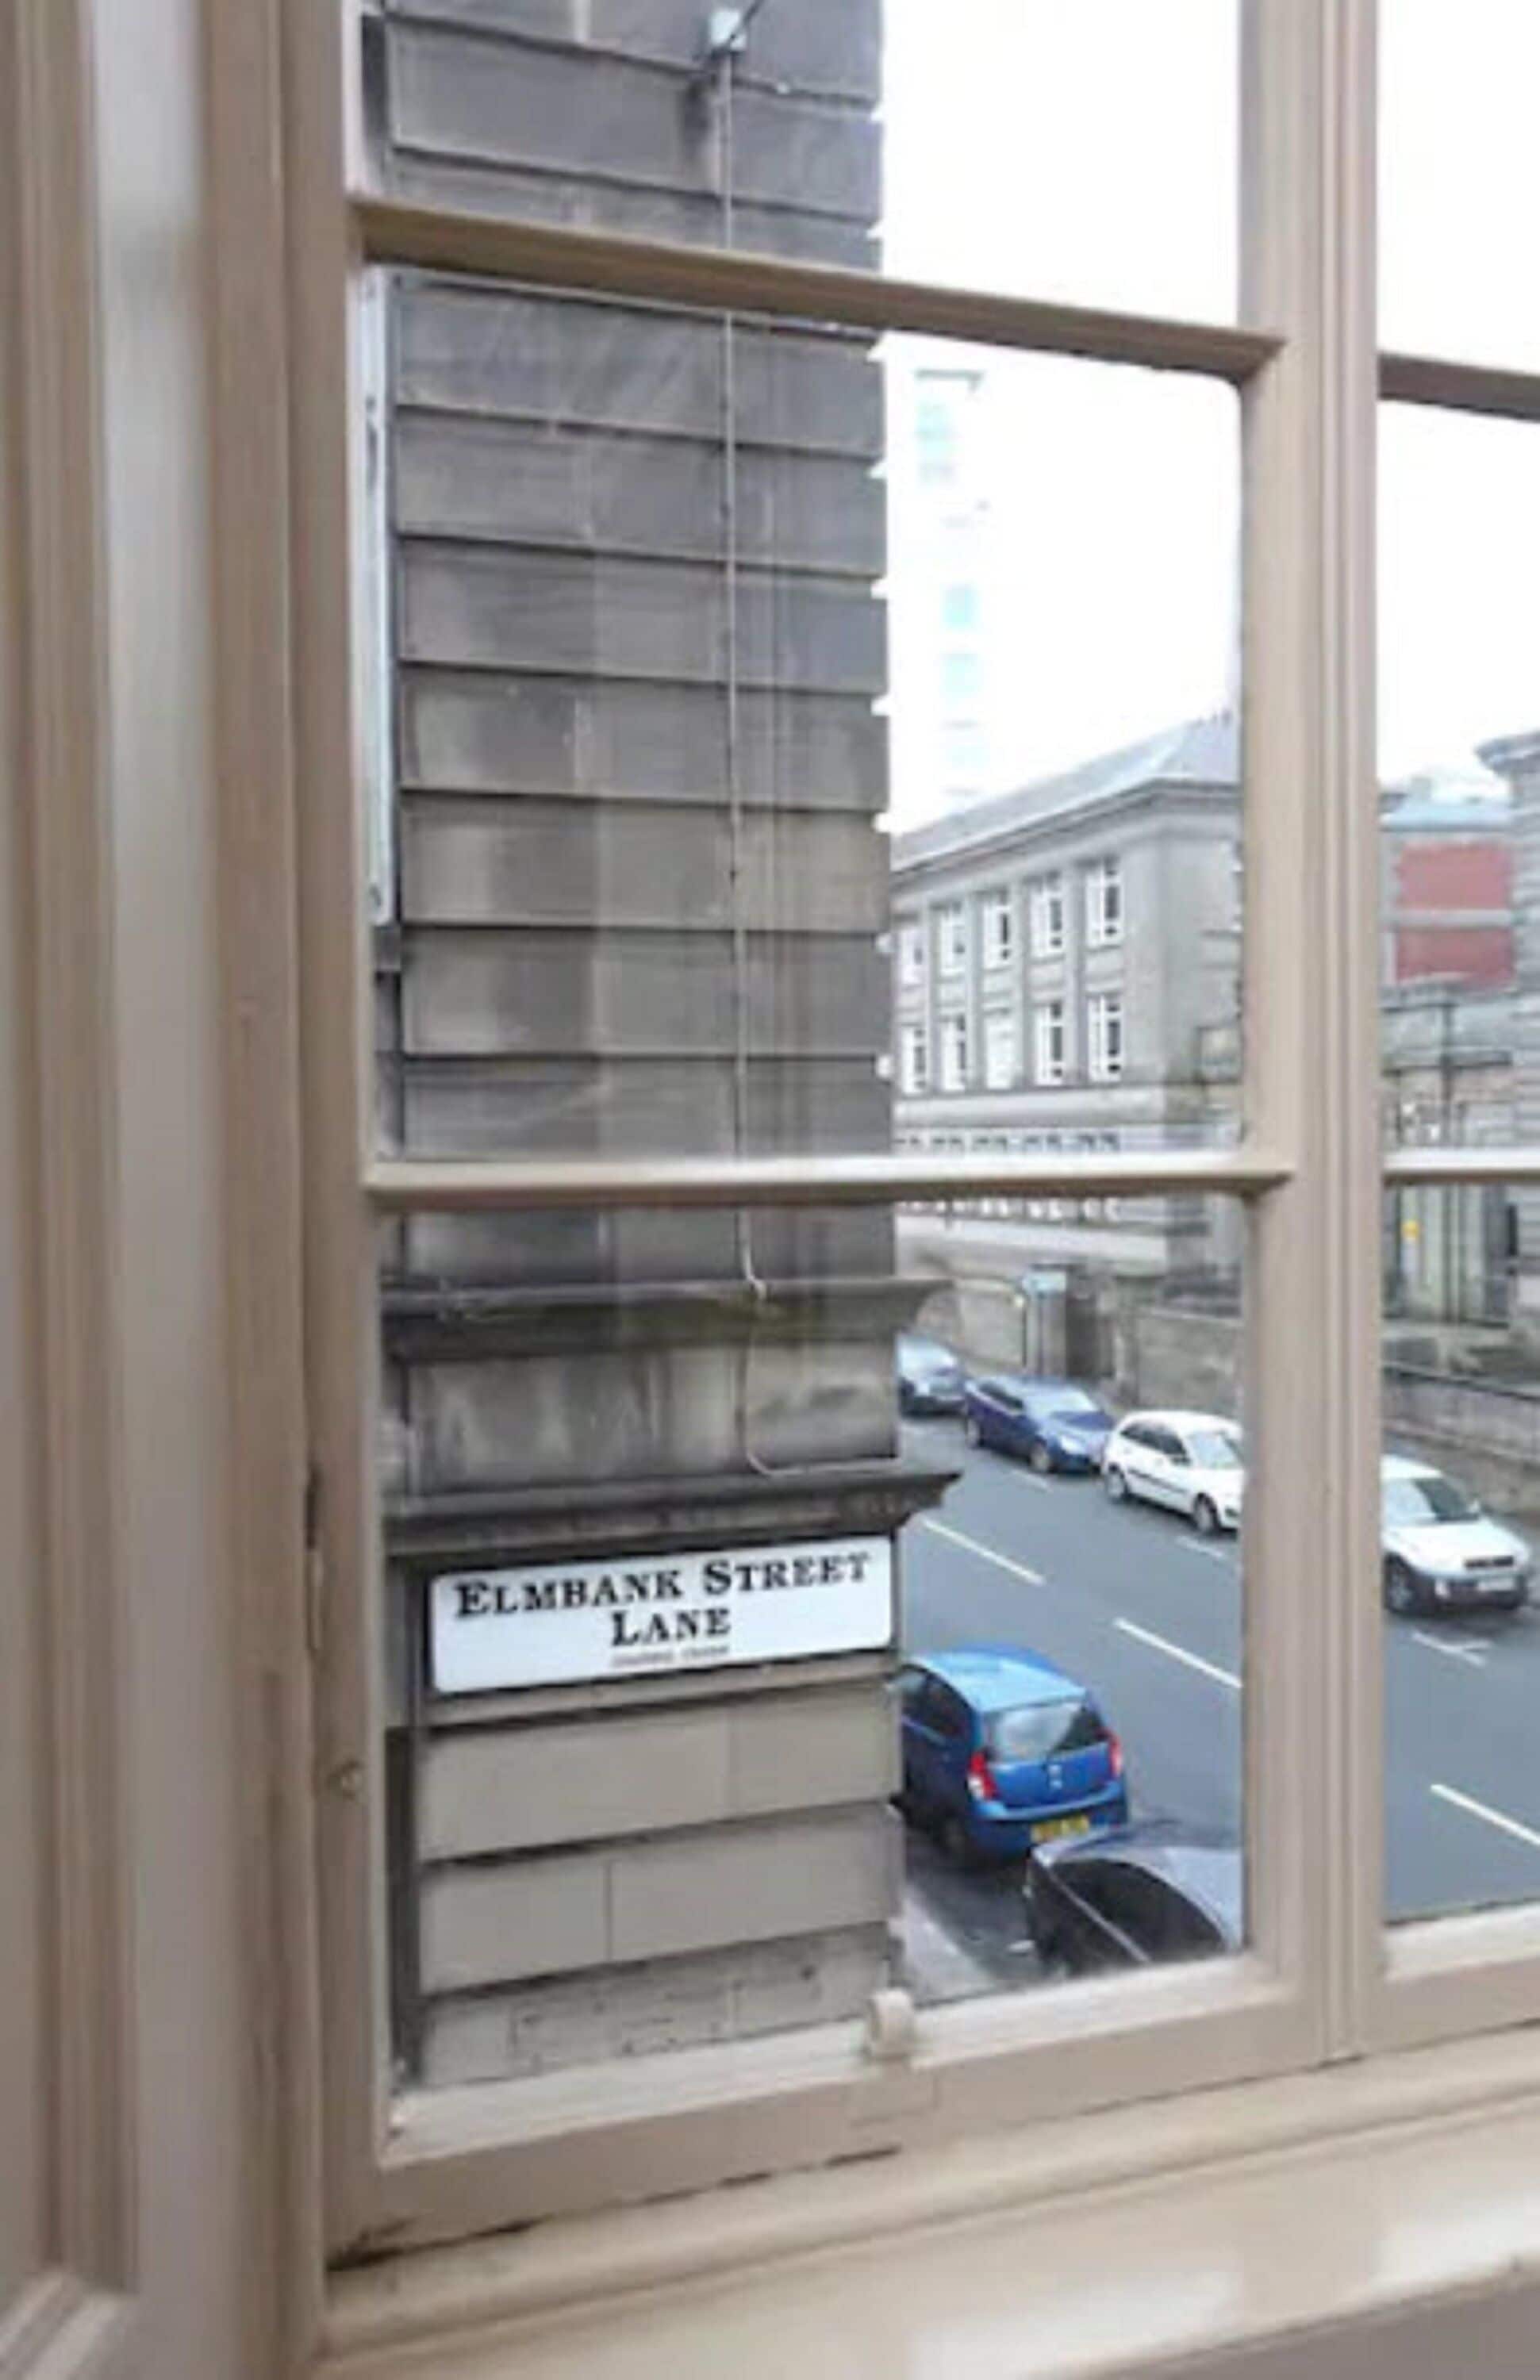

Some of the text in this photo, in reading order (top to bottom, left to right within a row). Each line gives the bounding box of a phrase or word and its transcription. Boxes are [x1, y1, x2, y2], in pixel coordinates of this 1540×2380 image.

[456, 1551, 870, 1618] ELMBANK STREET
[612, 1608, 731, 1646] LANE
